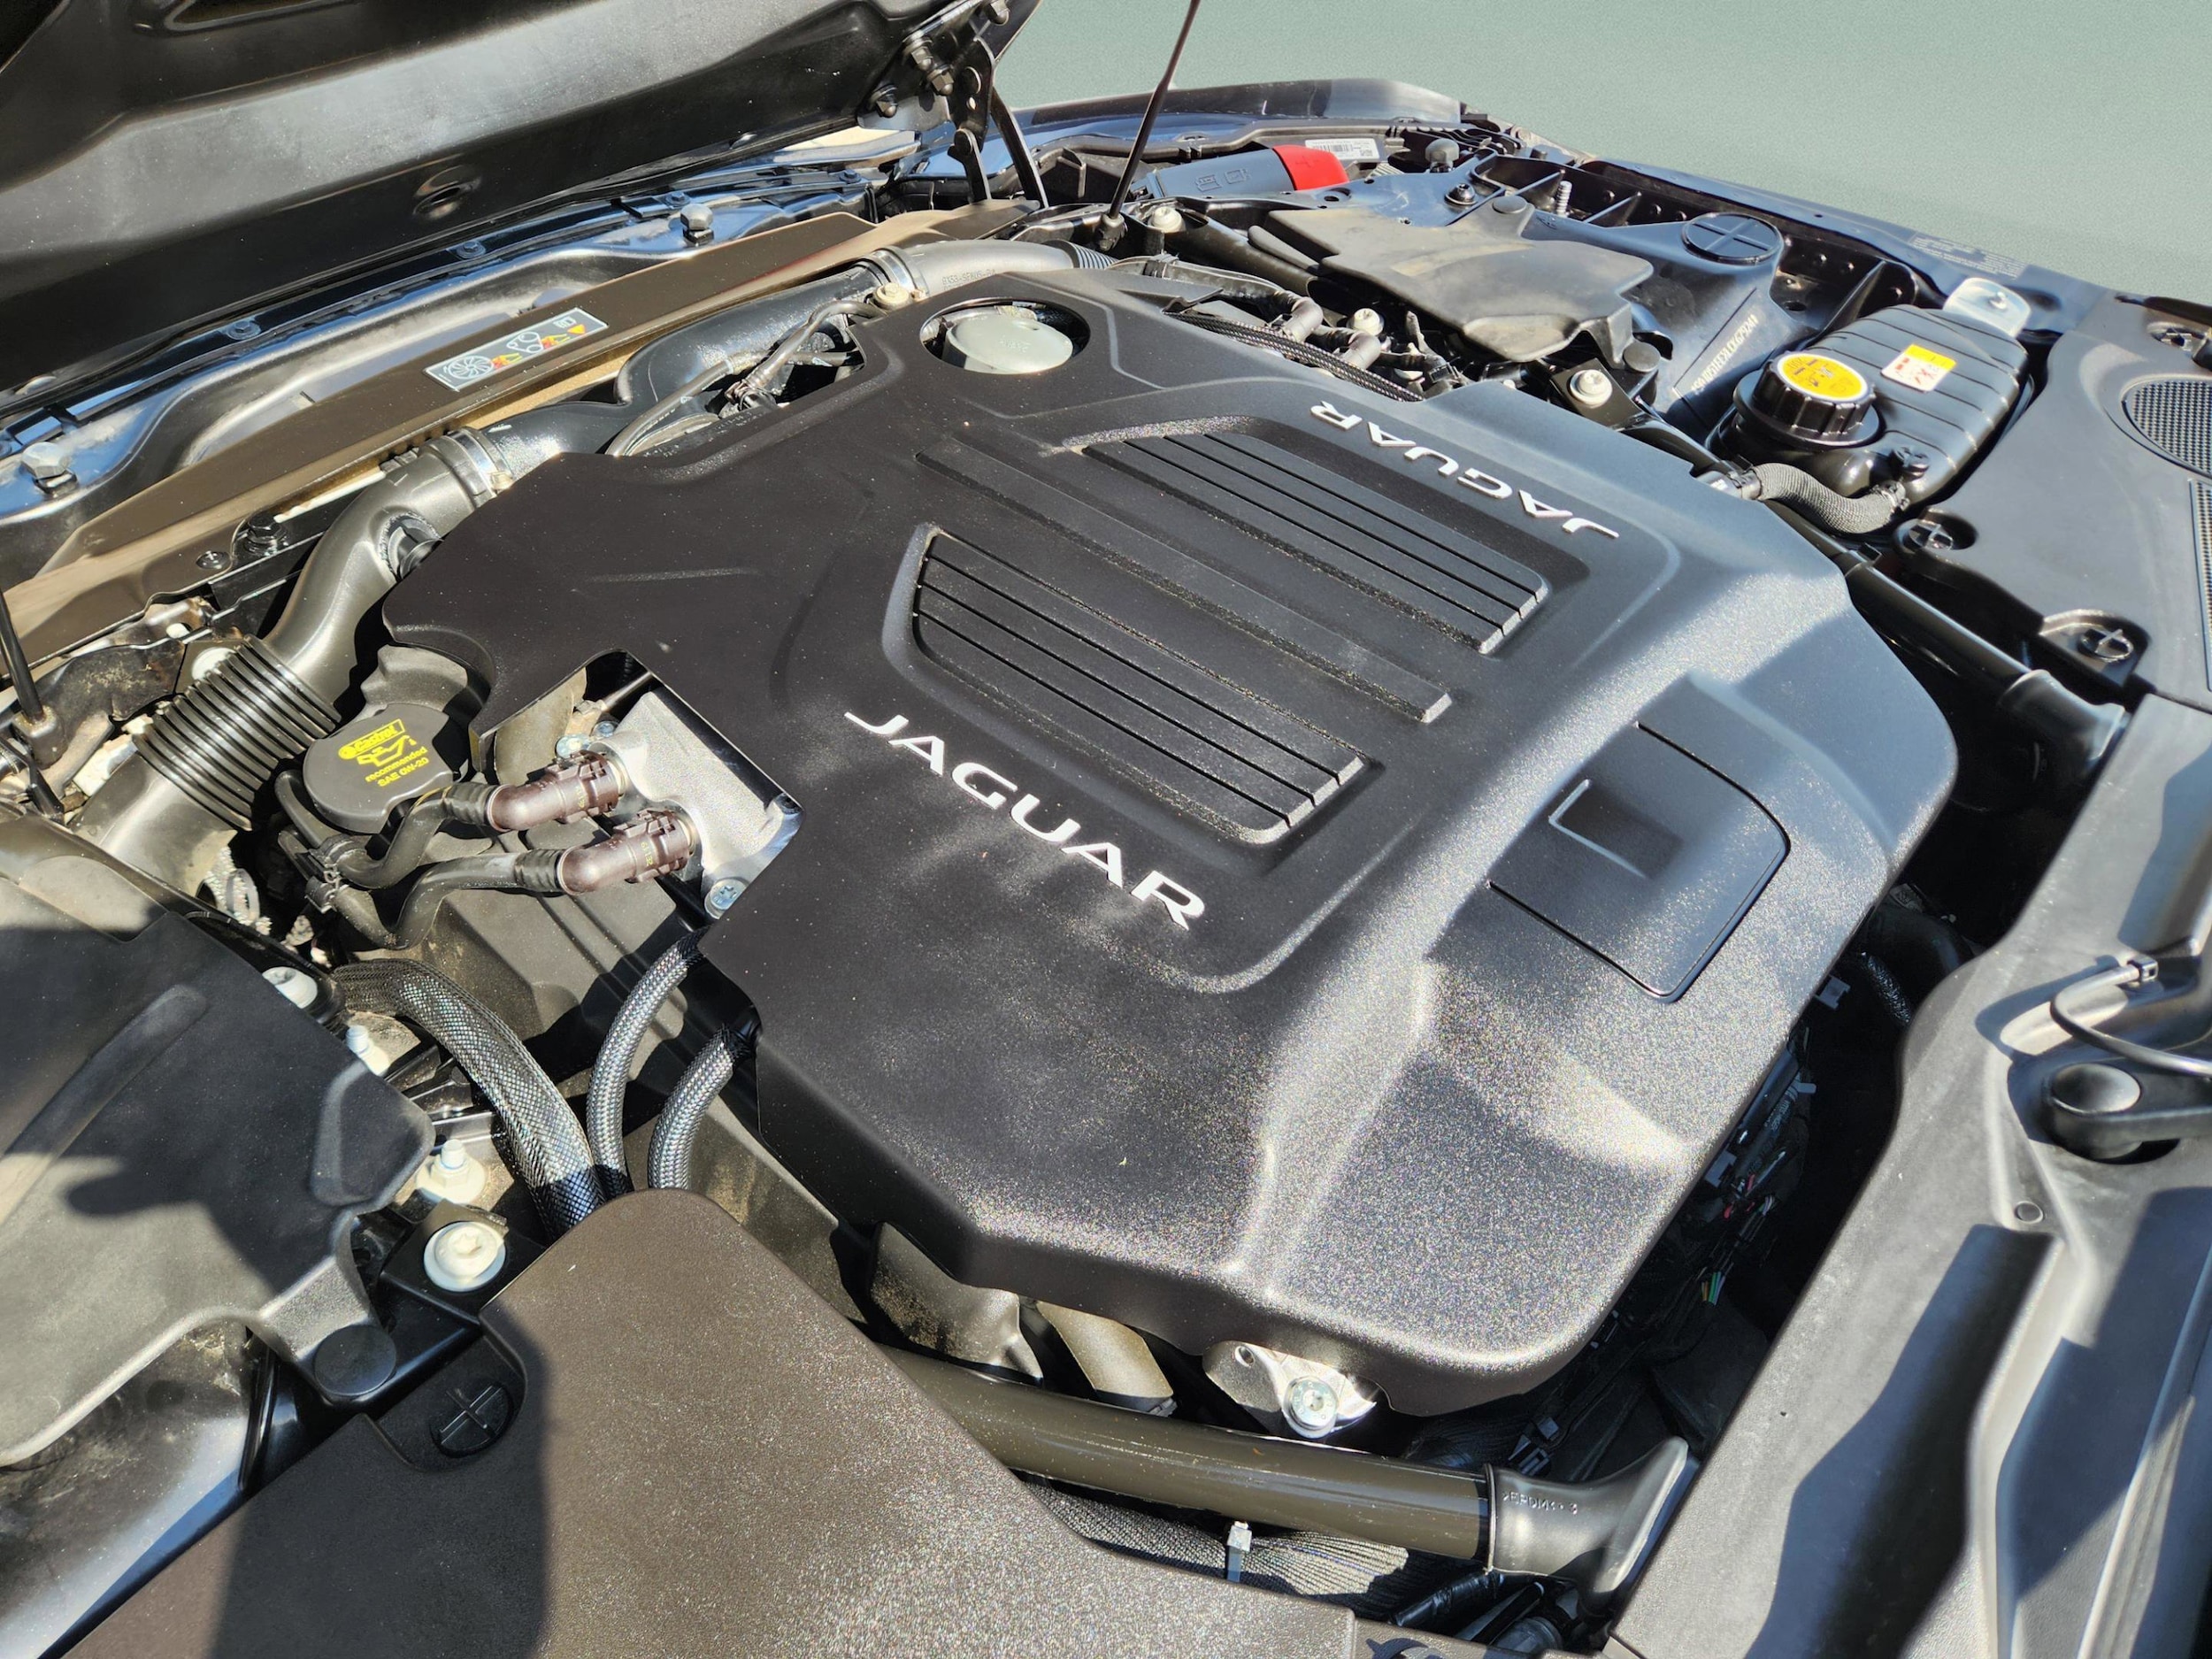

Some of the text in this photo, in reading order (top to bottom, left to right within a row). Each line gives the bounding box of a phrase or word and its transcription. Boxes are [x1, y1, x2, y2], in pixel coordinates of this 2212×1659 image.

[1310, 401, 1619, 538] JAGUAR
[354, 724, 398, 755] Castrol
[365, 746, 428, 782] recommended
[377, 757, 429, 787] SAE 0W-20
[844, 711, 1205, 931] JAGUAR
